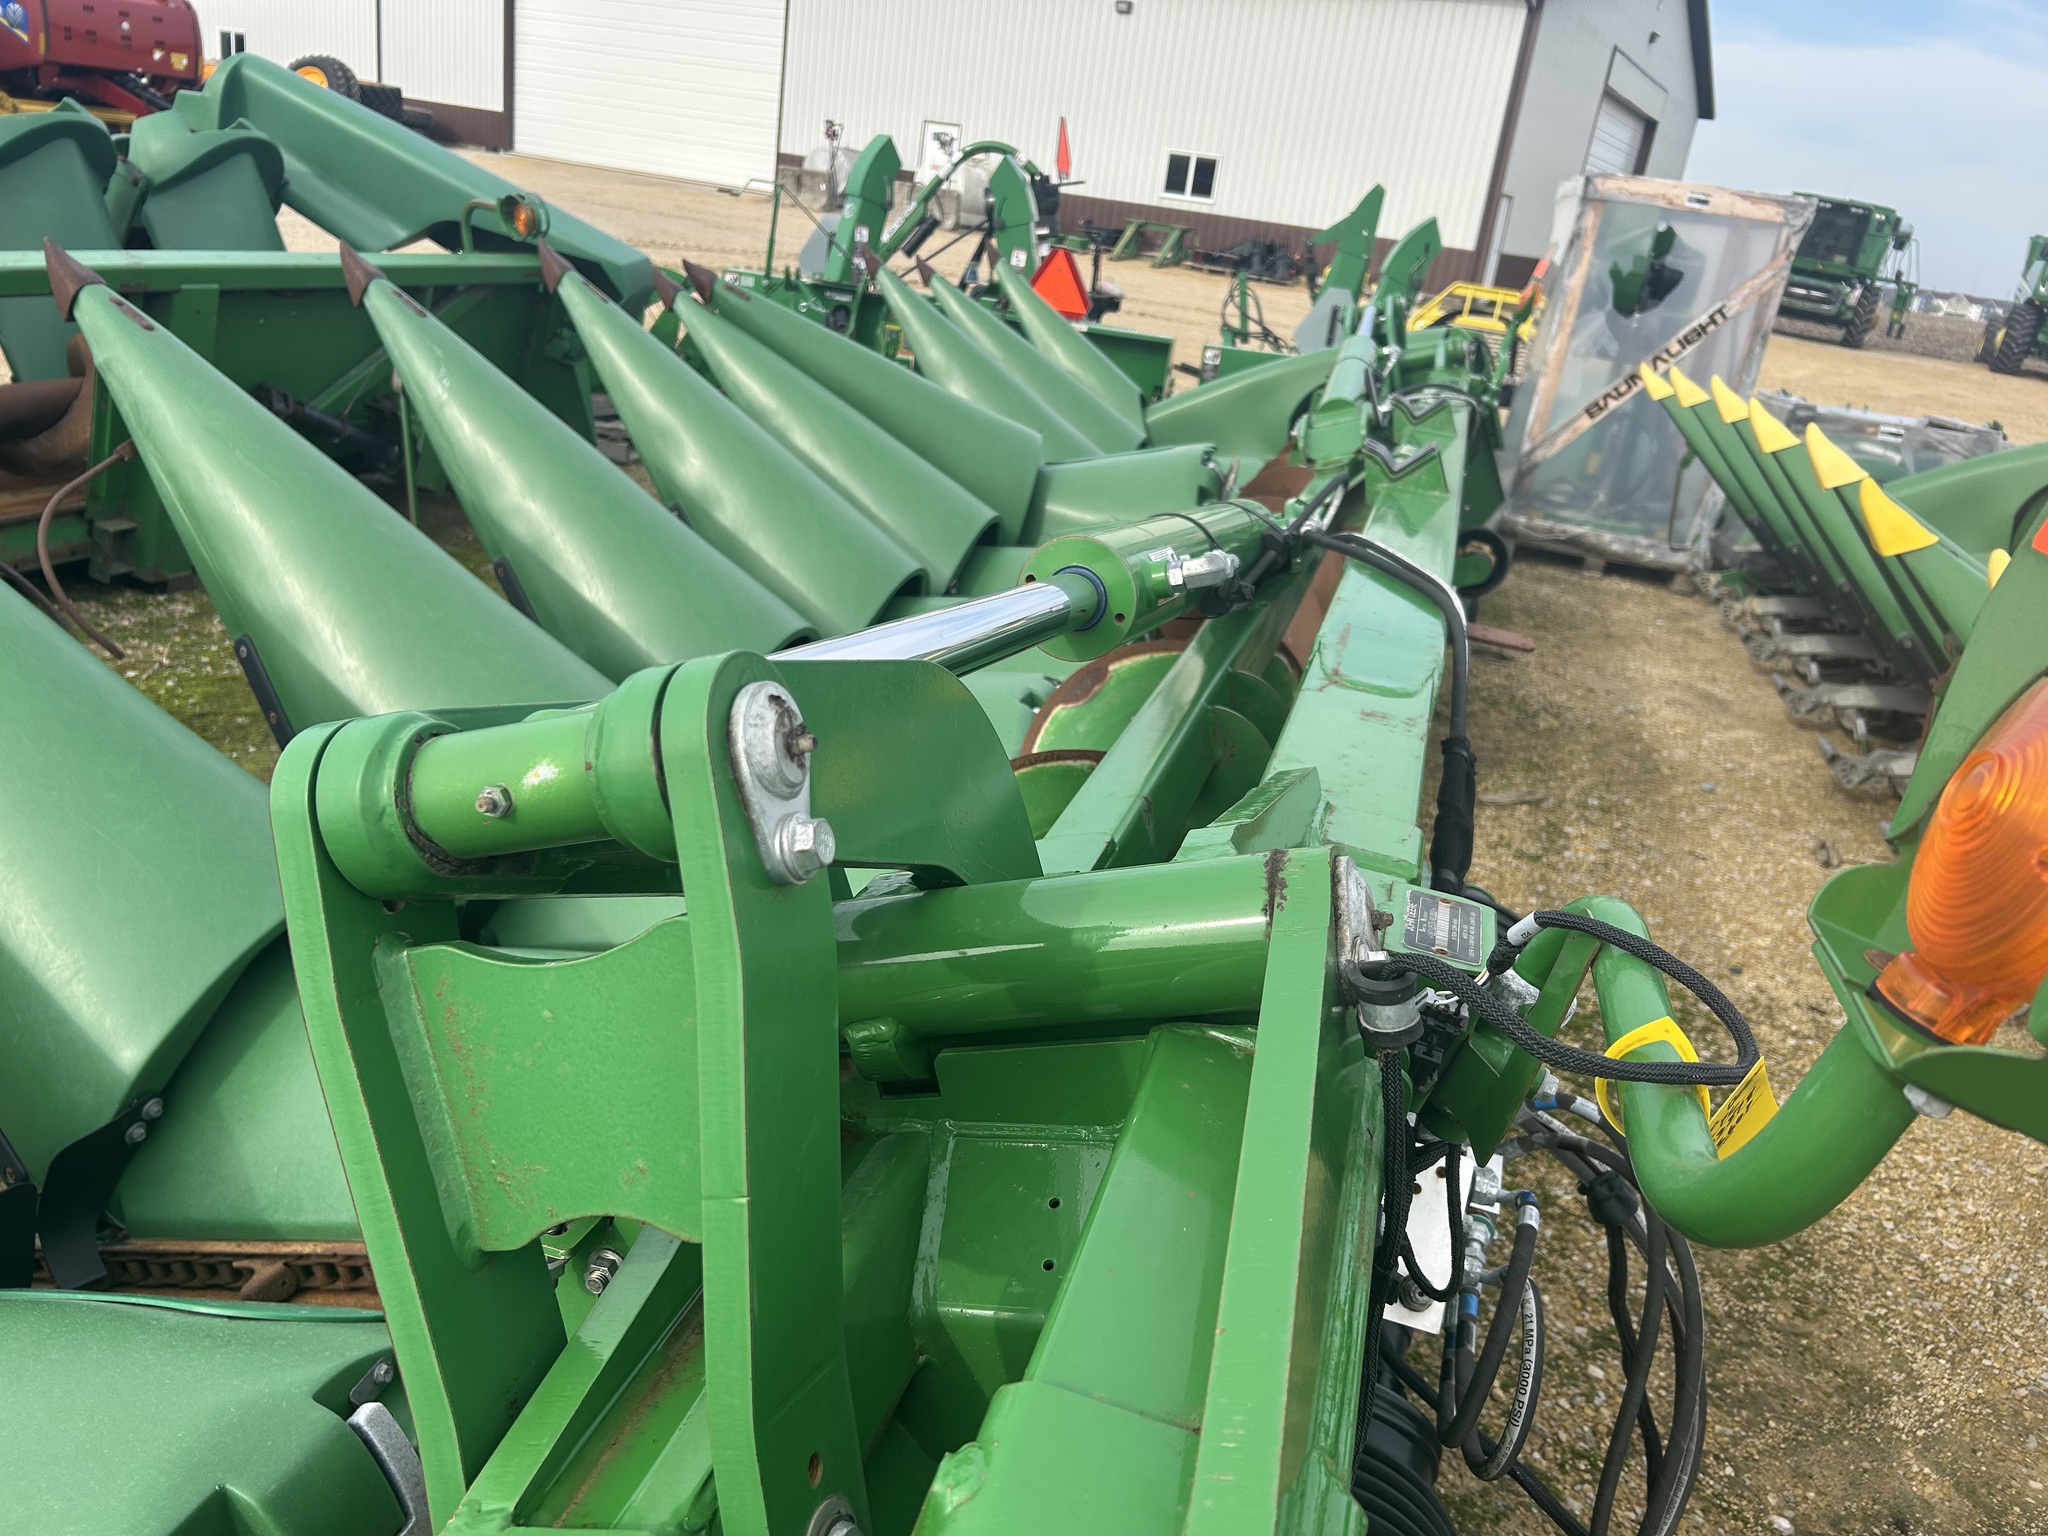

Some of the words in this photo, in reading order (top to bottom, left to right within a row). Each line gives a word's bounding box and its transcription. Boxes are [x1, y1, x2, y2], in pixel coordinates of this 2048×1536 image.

[1525, 1312, 1534, 1324] 21
[1524, 1328, 1534, 1354] MPa
[1518, 1359, 1533, 1396] (3000
[1510, 1398, 1525, 1427] PSI)
